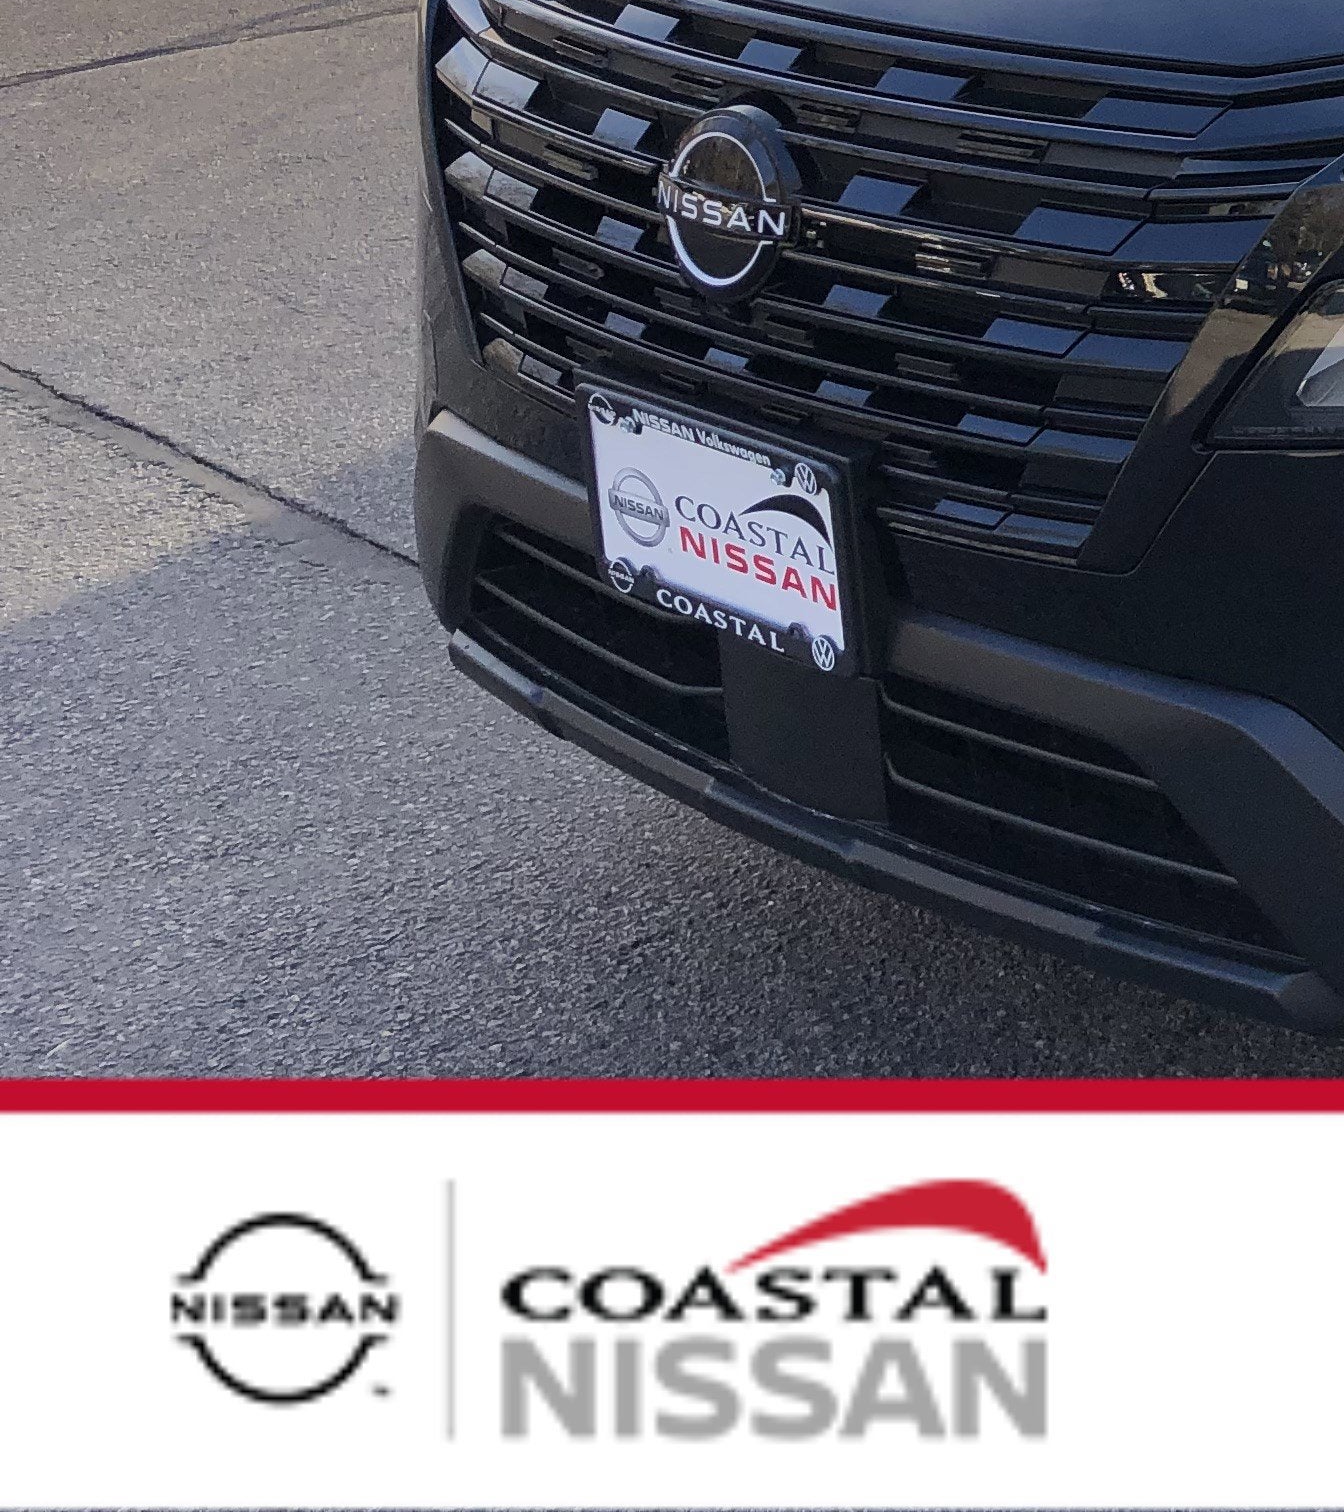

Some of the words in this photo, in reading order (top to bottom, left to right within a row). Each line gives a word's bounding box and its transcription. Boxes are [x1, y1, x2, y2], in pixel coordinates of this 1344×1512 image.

[657, 180, 785, 236] NISSAN
[631, 408, 695, 442] NISSAN
[695, 428, 771, 466] Volkswagen
[613, 492, 665, 522] NISSAN
[674, 495, 835, 576] COASTAL
[679, 525, 838, 612] NISSAN
[656, 588, 785, 654] COASTAL
